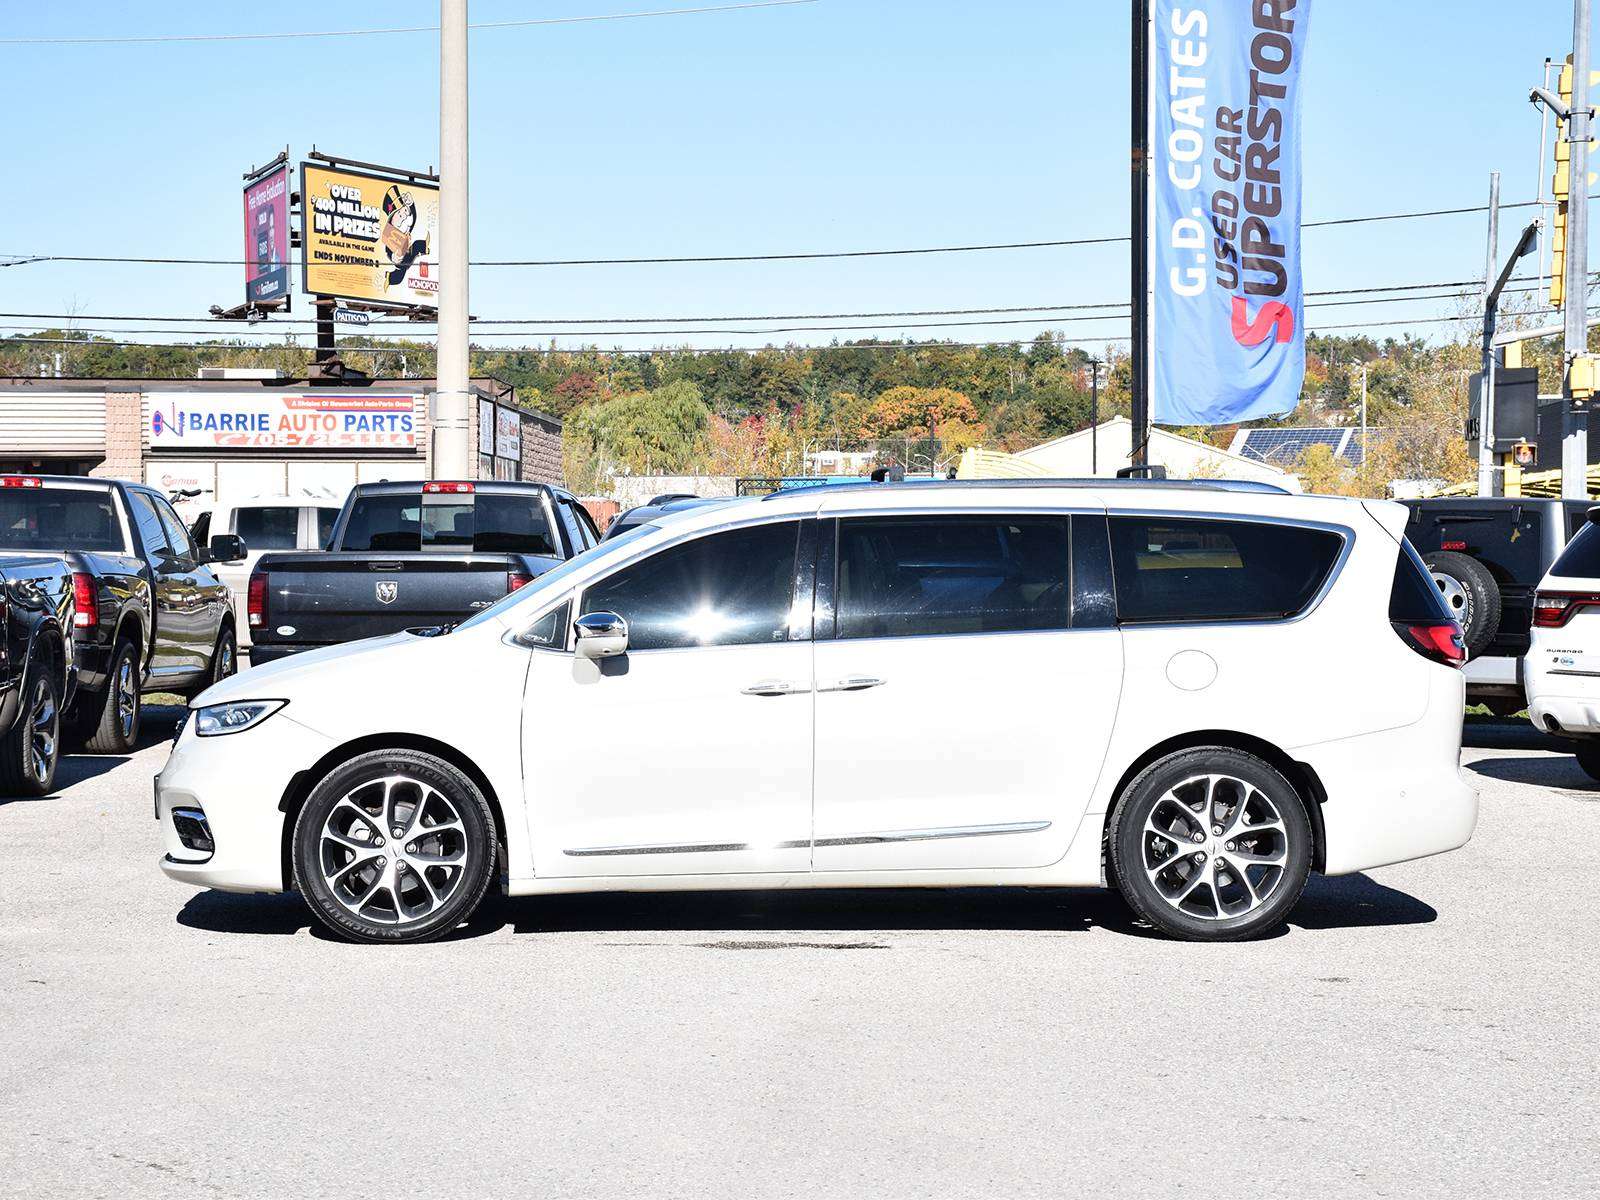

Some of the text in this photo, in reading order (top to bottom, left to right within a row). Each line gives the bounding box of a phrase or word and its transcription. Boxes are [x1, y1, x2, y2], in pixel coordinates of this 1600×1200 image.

[1168, 8, 1208, 297] G.D. COATES
[330, 184, 362, 201] OVER
[1211, 106, 1243, 290] USED CAR
[311, 195, 380, 220] $400 MILLION
[314, 213, 381, 240] IN PRIZES
[318, 239, 345, 249] AVAILABLE
[352, 243, 361, 251] THE
[314, 250, 334, 261] ENDS
[334, 253, 374, 267] NOVEMBER
[336, 311, 370, 323] PATTISON
[189, 413, 413, 432] BARRIE AUTO PARTS
